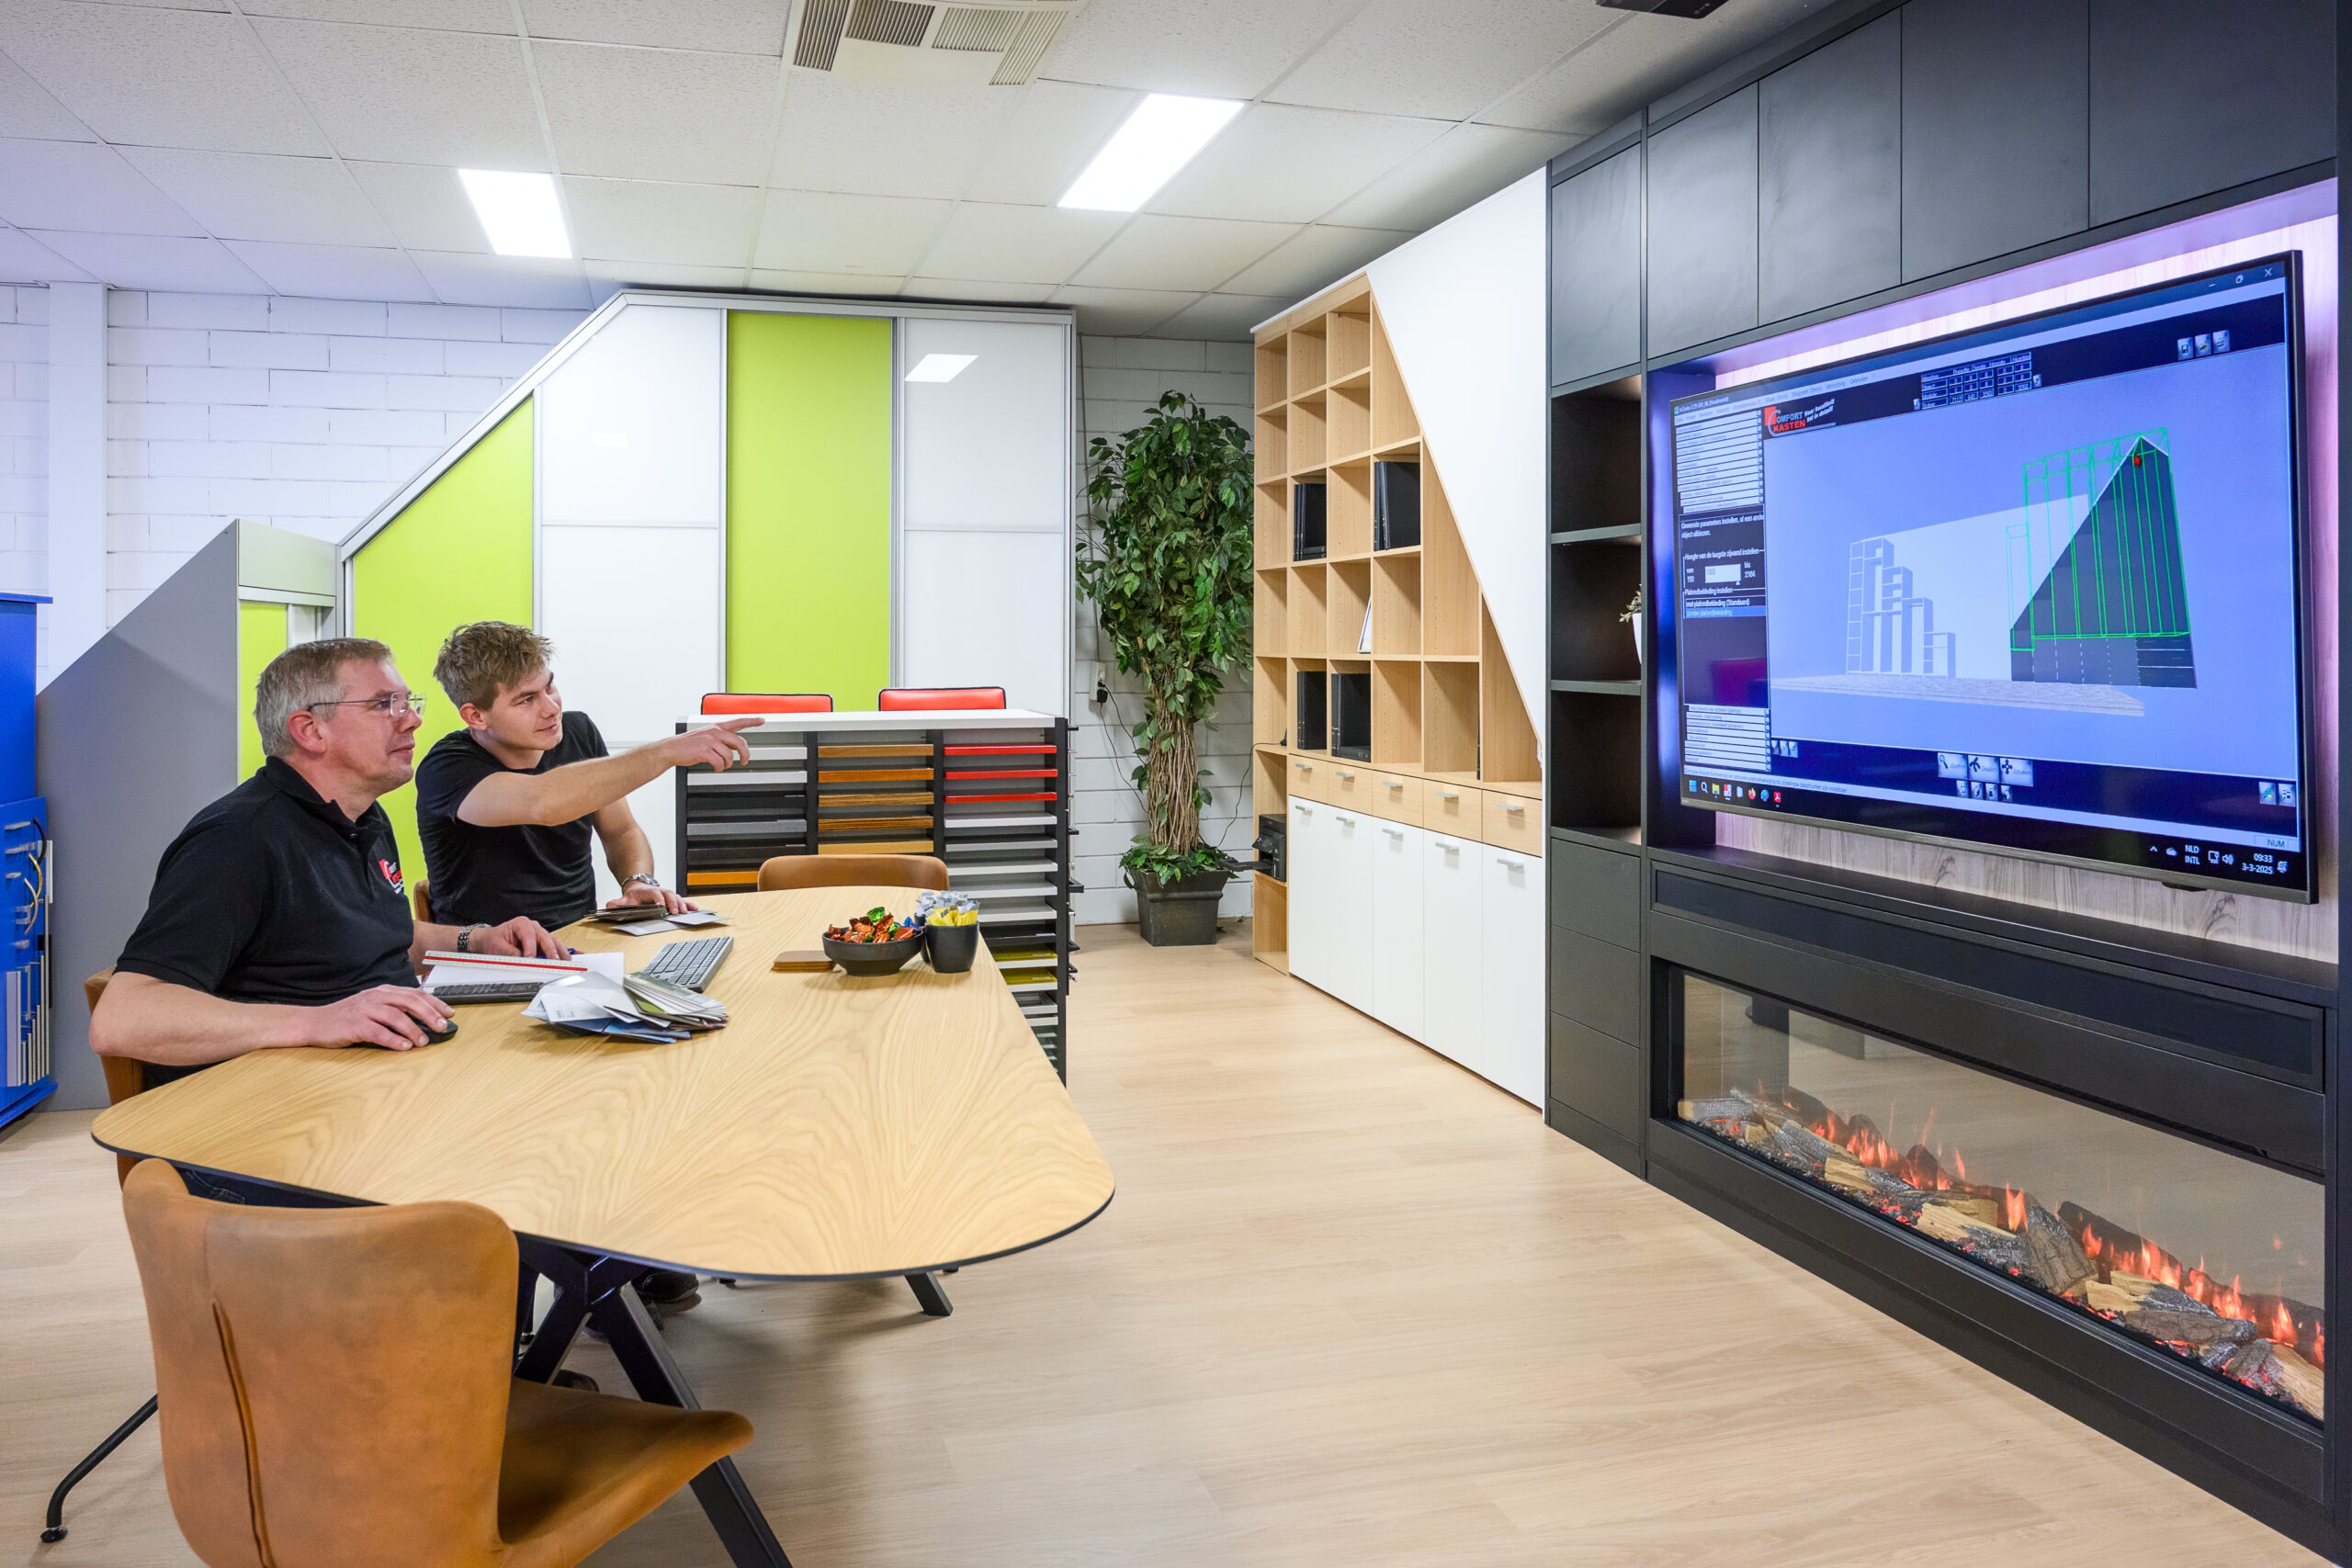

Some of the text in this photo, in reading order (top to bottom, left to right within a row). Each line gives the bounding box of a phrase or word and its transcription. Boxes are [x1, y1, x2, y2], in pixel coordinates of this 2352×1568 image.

[1773, 419, 1806, 433] KASTEN
[2267, 839, 2285, 848] NUM
[2185, 844, 2199, 854] NLD
[2185, 855, 2200, 865] INTL
[2254, 852, 2274, 863] 09:33
[2242, 863, 2274, 874] 3-3-2025
